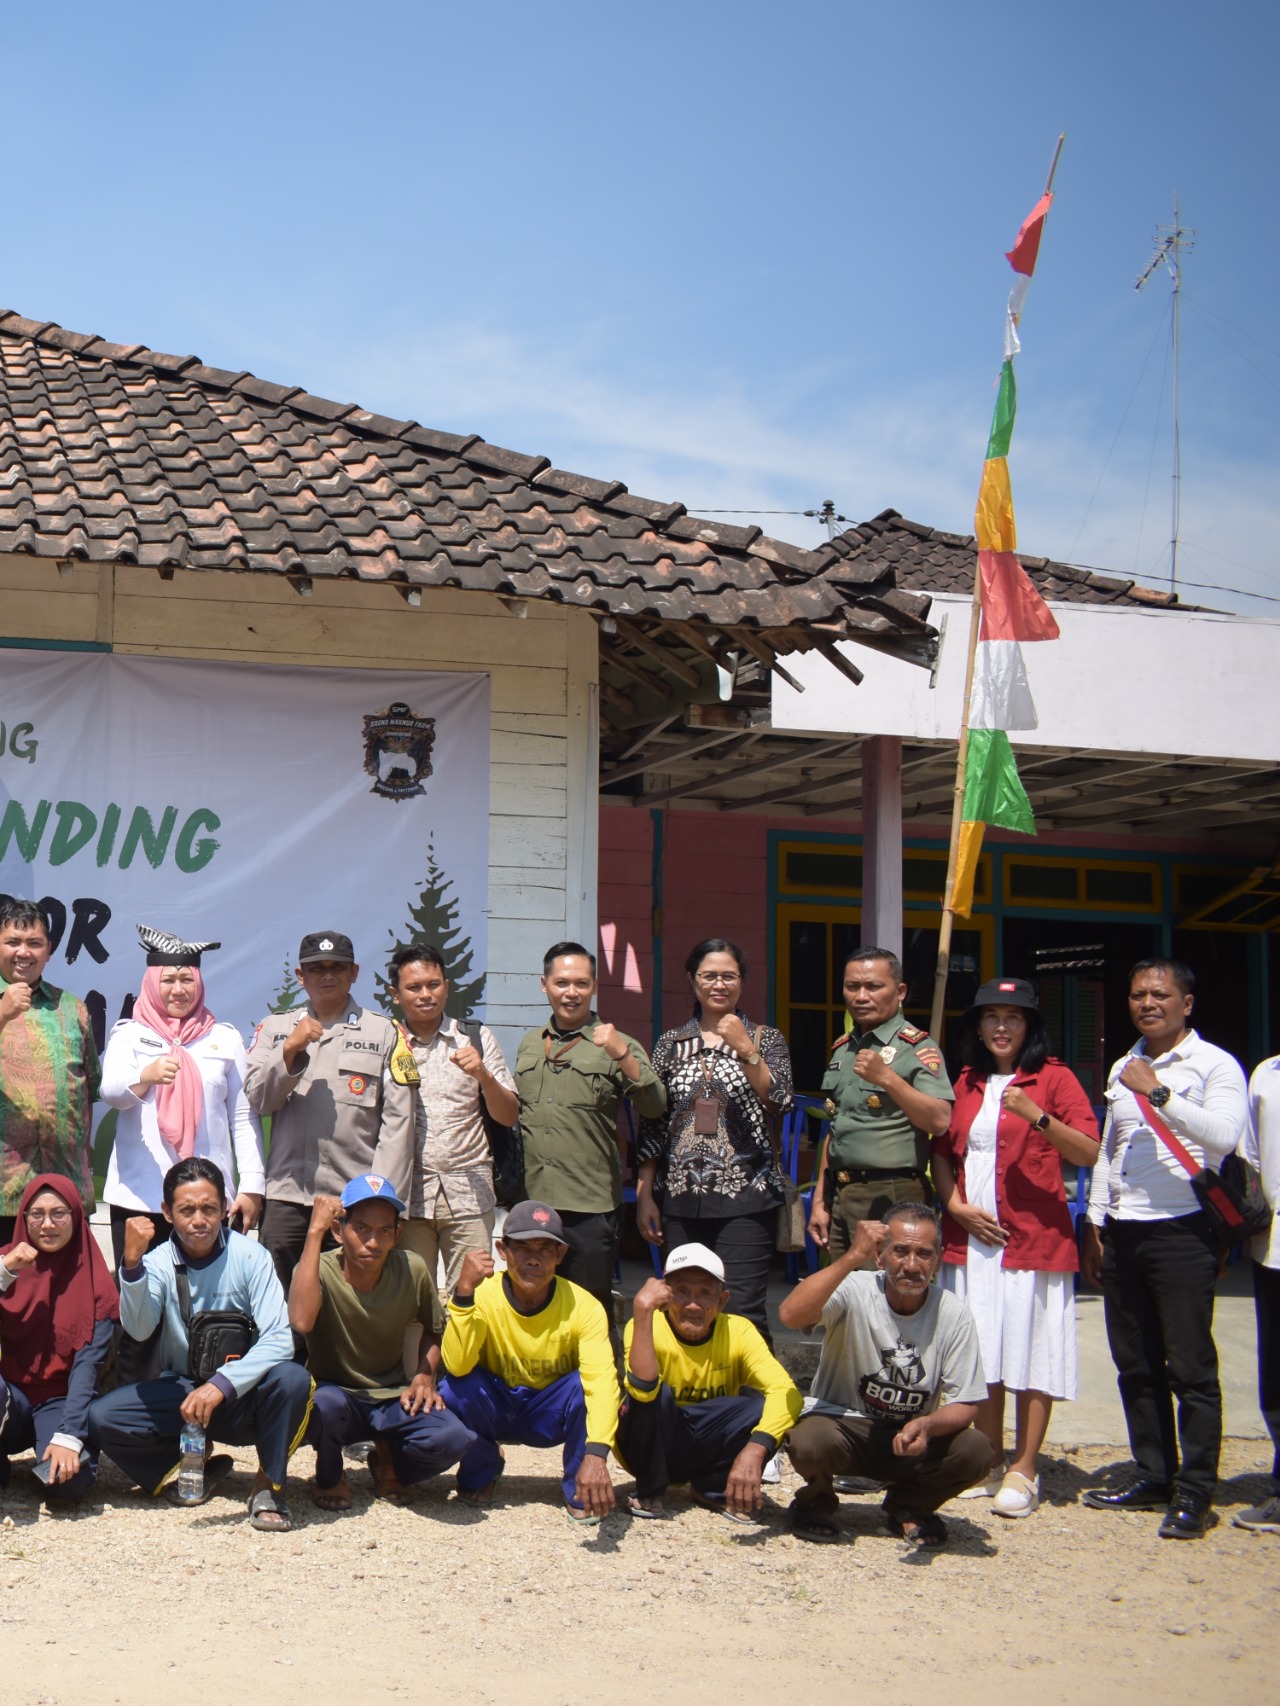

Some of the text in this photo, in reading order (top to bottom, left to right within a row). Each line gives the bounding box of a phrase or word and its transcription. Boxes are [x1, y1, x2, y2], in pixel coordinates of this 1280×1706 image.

[345, 1041, 380, 1052] POLRI
[865, 1381, 924, 1407] BOLD
[888, 1404, 921, 1412] WORLD
